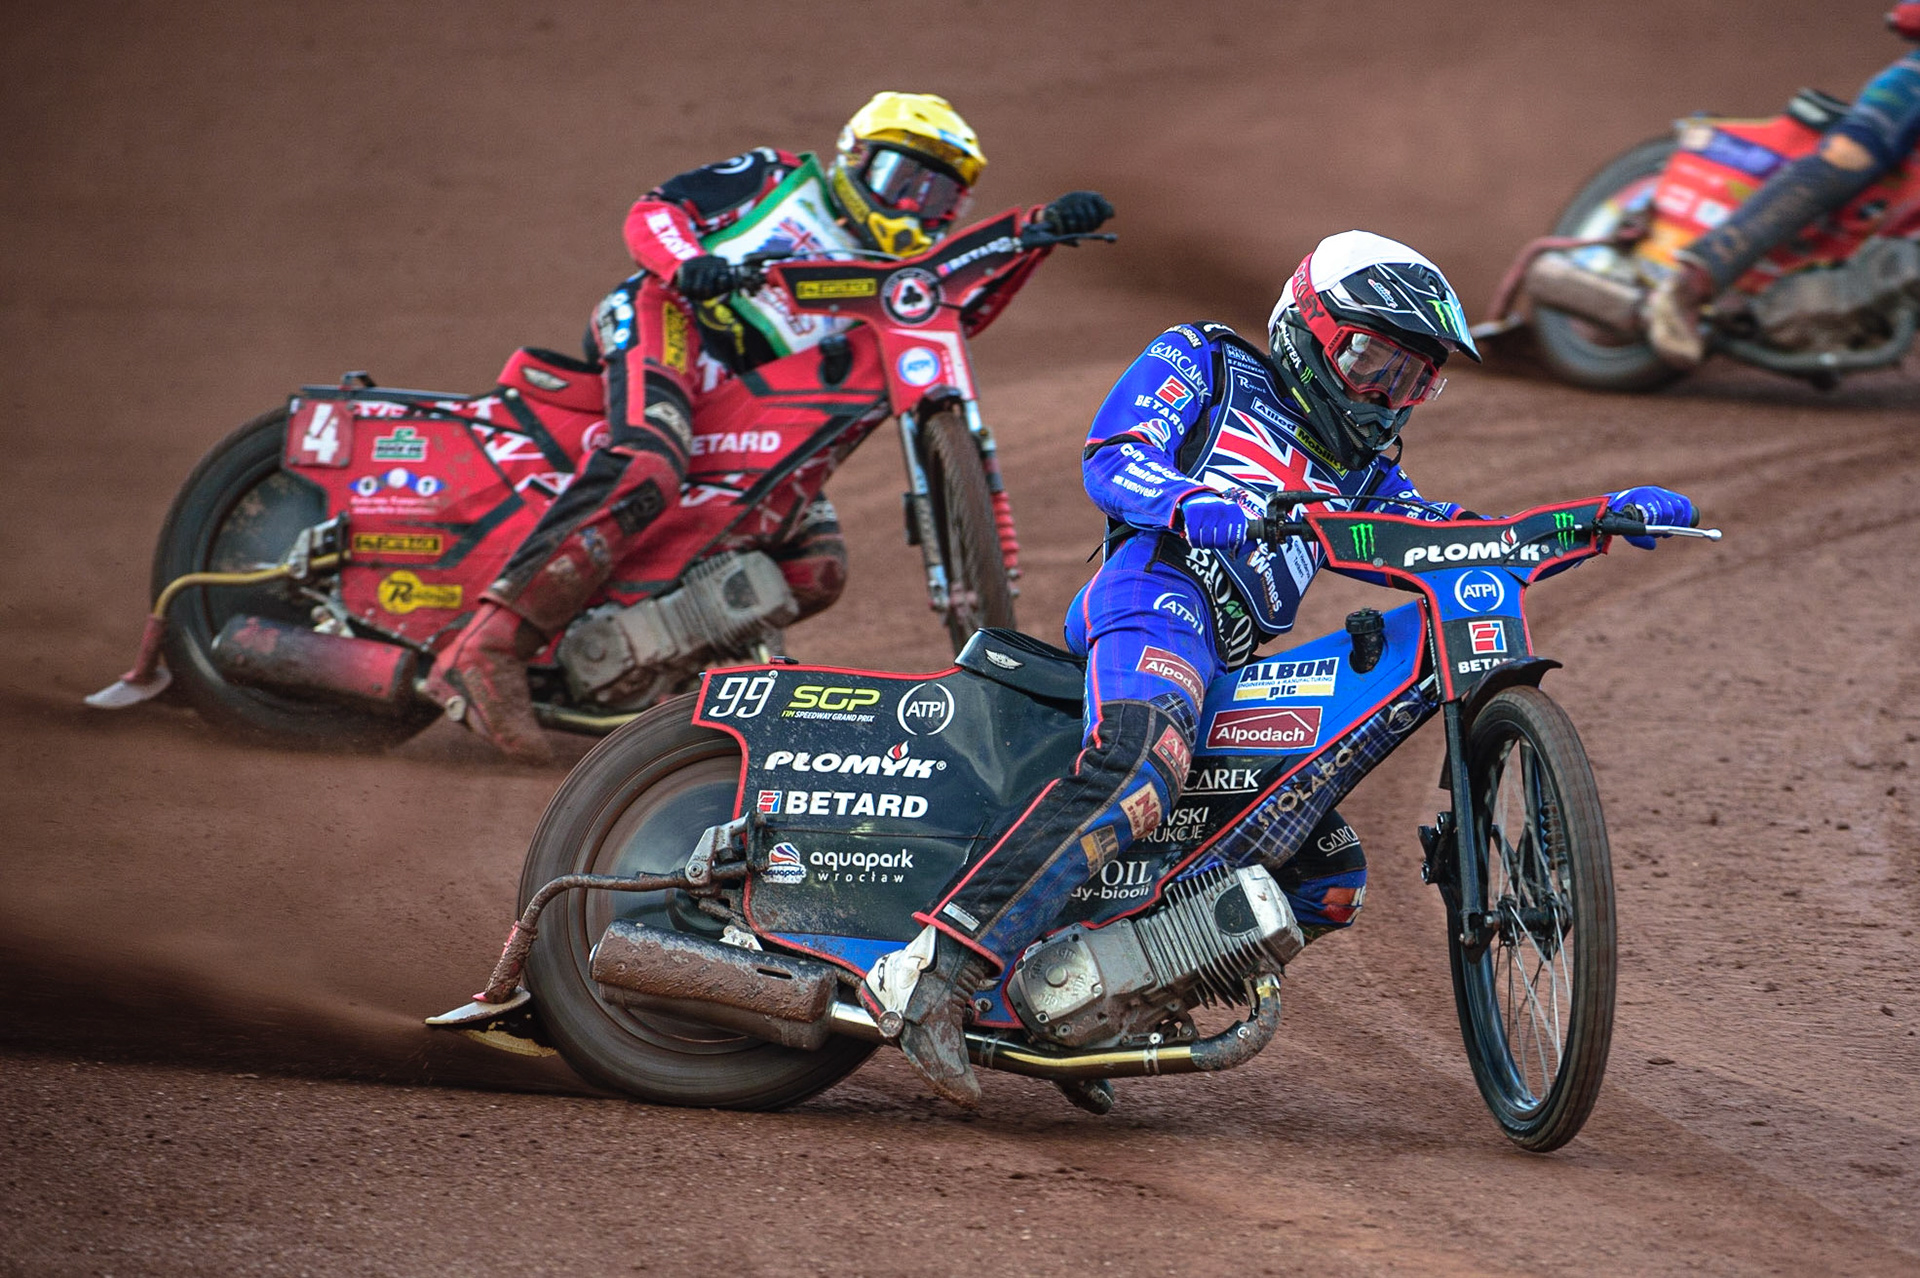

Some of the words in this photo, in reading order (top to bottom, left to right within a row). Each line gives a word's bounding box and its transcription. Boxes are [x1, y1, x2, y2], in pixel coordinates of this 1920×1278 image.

[1294, 262, 1325, 321] OAKLEY
[1134, 394, 1185, 436] BETARD
[1256, 404, 1297, 431] Allied
[302, 403, 340, 463] 4
[691, 431, 781, 456] ETARD
[1463, 584, 1497, 598] ATPI
[1240, 659, 1337, 682] ALBON
[1458, 658, 1517, 674] BETA
[708, 676, 776, 718] 99
[789, 685, 881, 711] SGP
[905, 701, 946, 718] ATPI
[795, 711, 833, 721] SPEEDWAY
[832, 713, 855, 722] GRAND
[1216, 726, 1305, 743] Alpodach
[1183, 768, 1261, 791] CAREK
[784, 790, 928, 819] BETARD
[809, 848, 914, 872] aquapark
[1101, 860, 1153, 886] OIL
